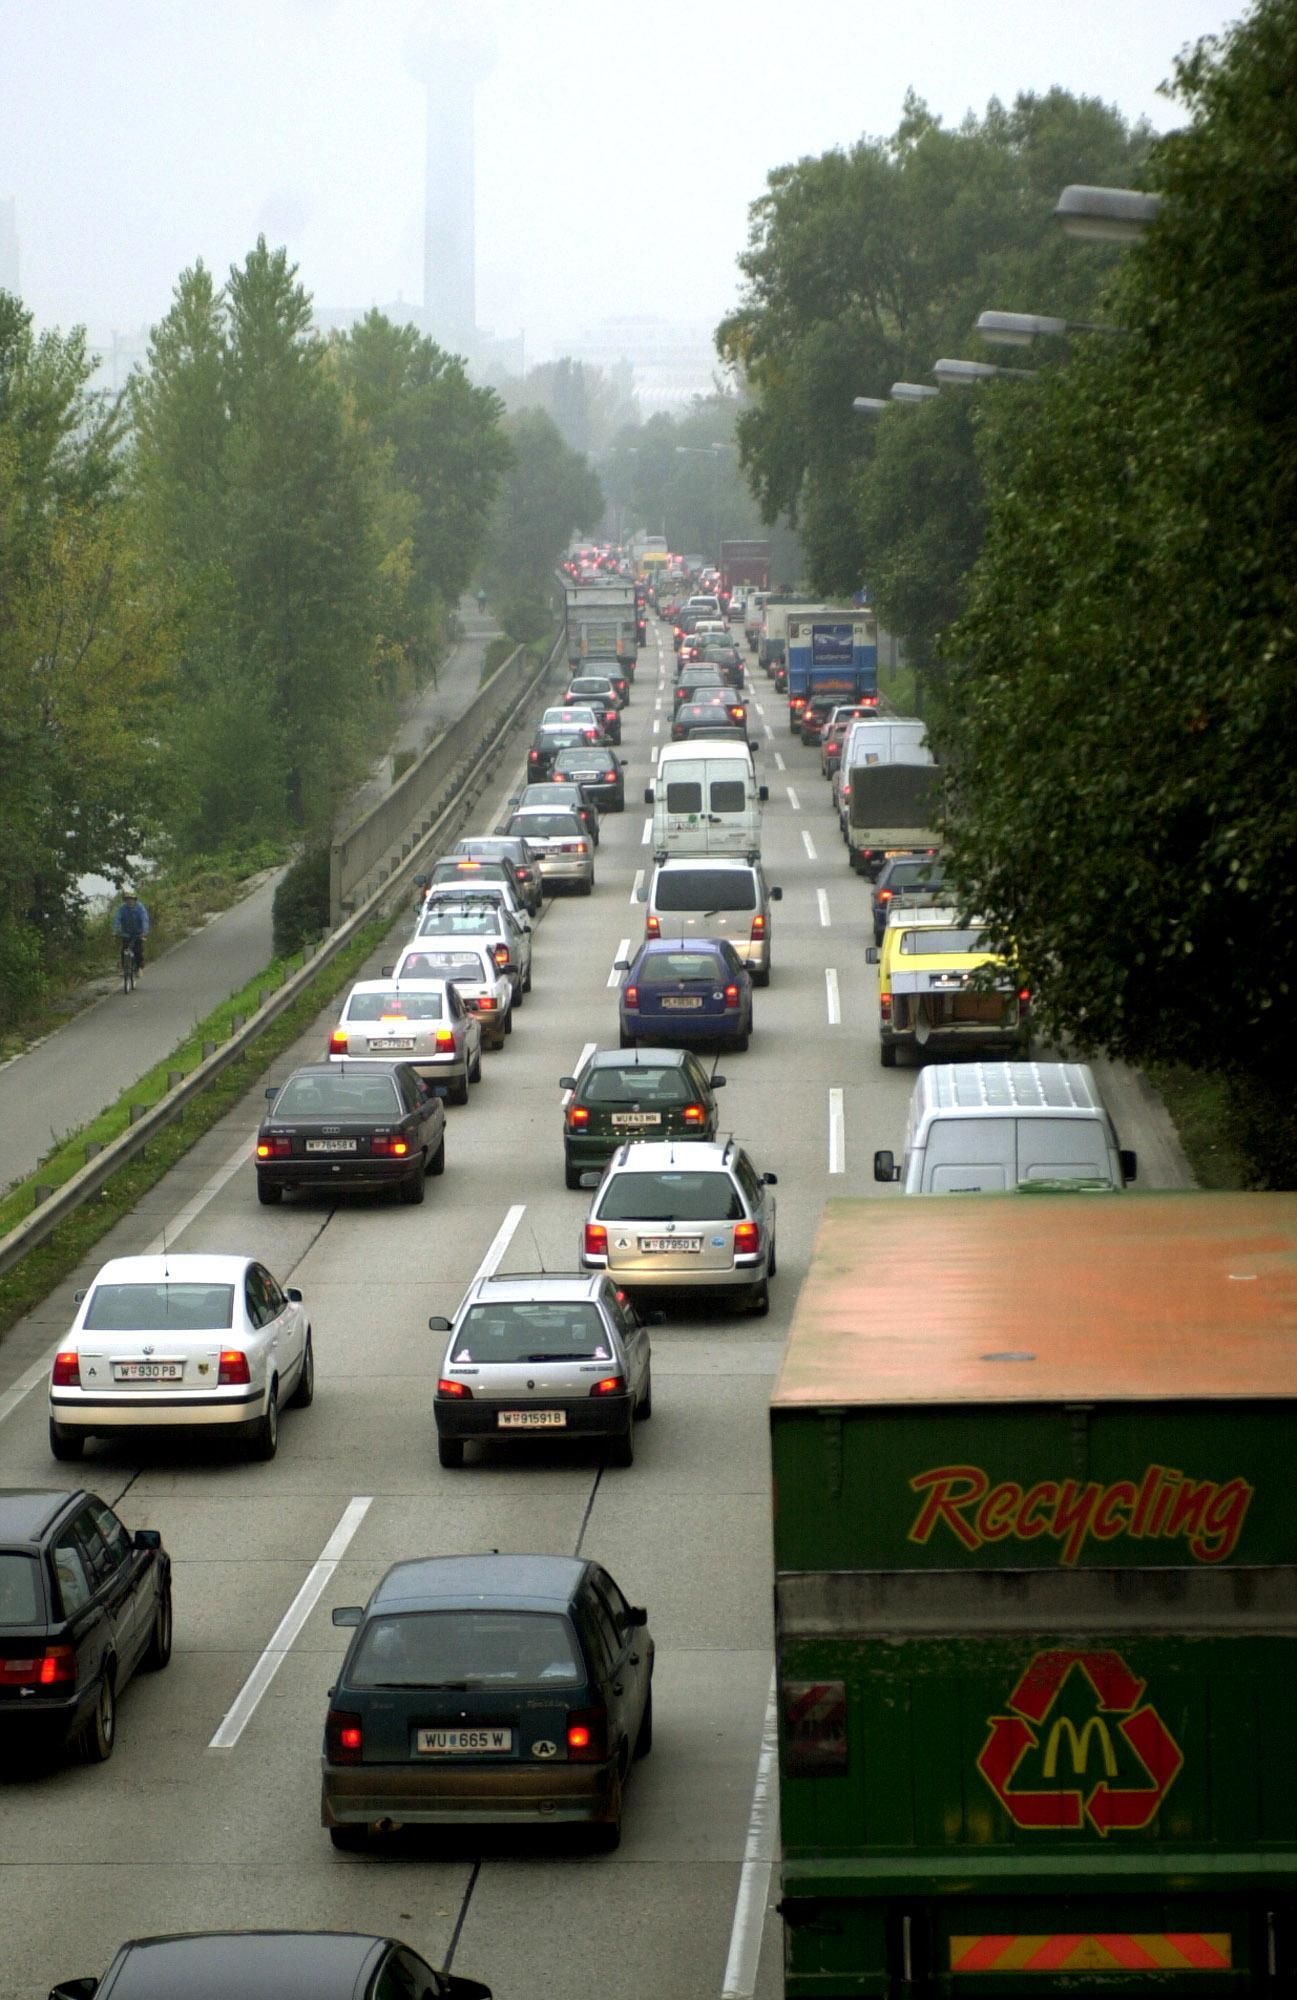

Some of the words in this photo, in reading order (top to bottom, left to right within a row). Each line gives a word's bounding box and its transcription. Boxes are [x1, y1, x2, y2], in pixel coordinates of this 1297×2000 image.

[618, 1239, 627, 1248] A
[644, 1239, 652, 1249] W
[88, 1367, 97, 1377] A
[120, 1366, 129, 1376] W
[138, 1365, 160, 1377] 930
[161, 1365, 176, 1376] PB
[503, 1412, 512, 1424] W
[908, 1464, 1253, 1566] Recycling
[425, 1733, 447, 1747] WU
[459, 1732, 489, 1747] 665
[492, 1732, 504, 1747] W
[538, 1741, 550, 1754] A
